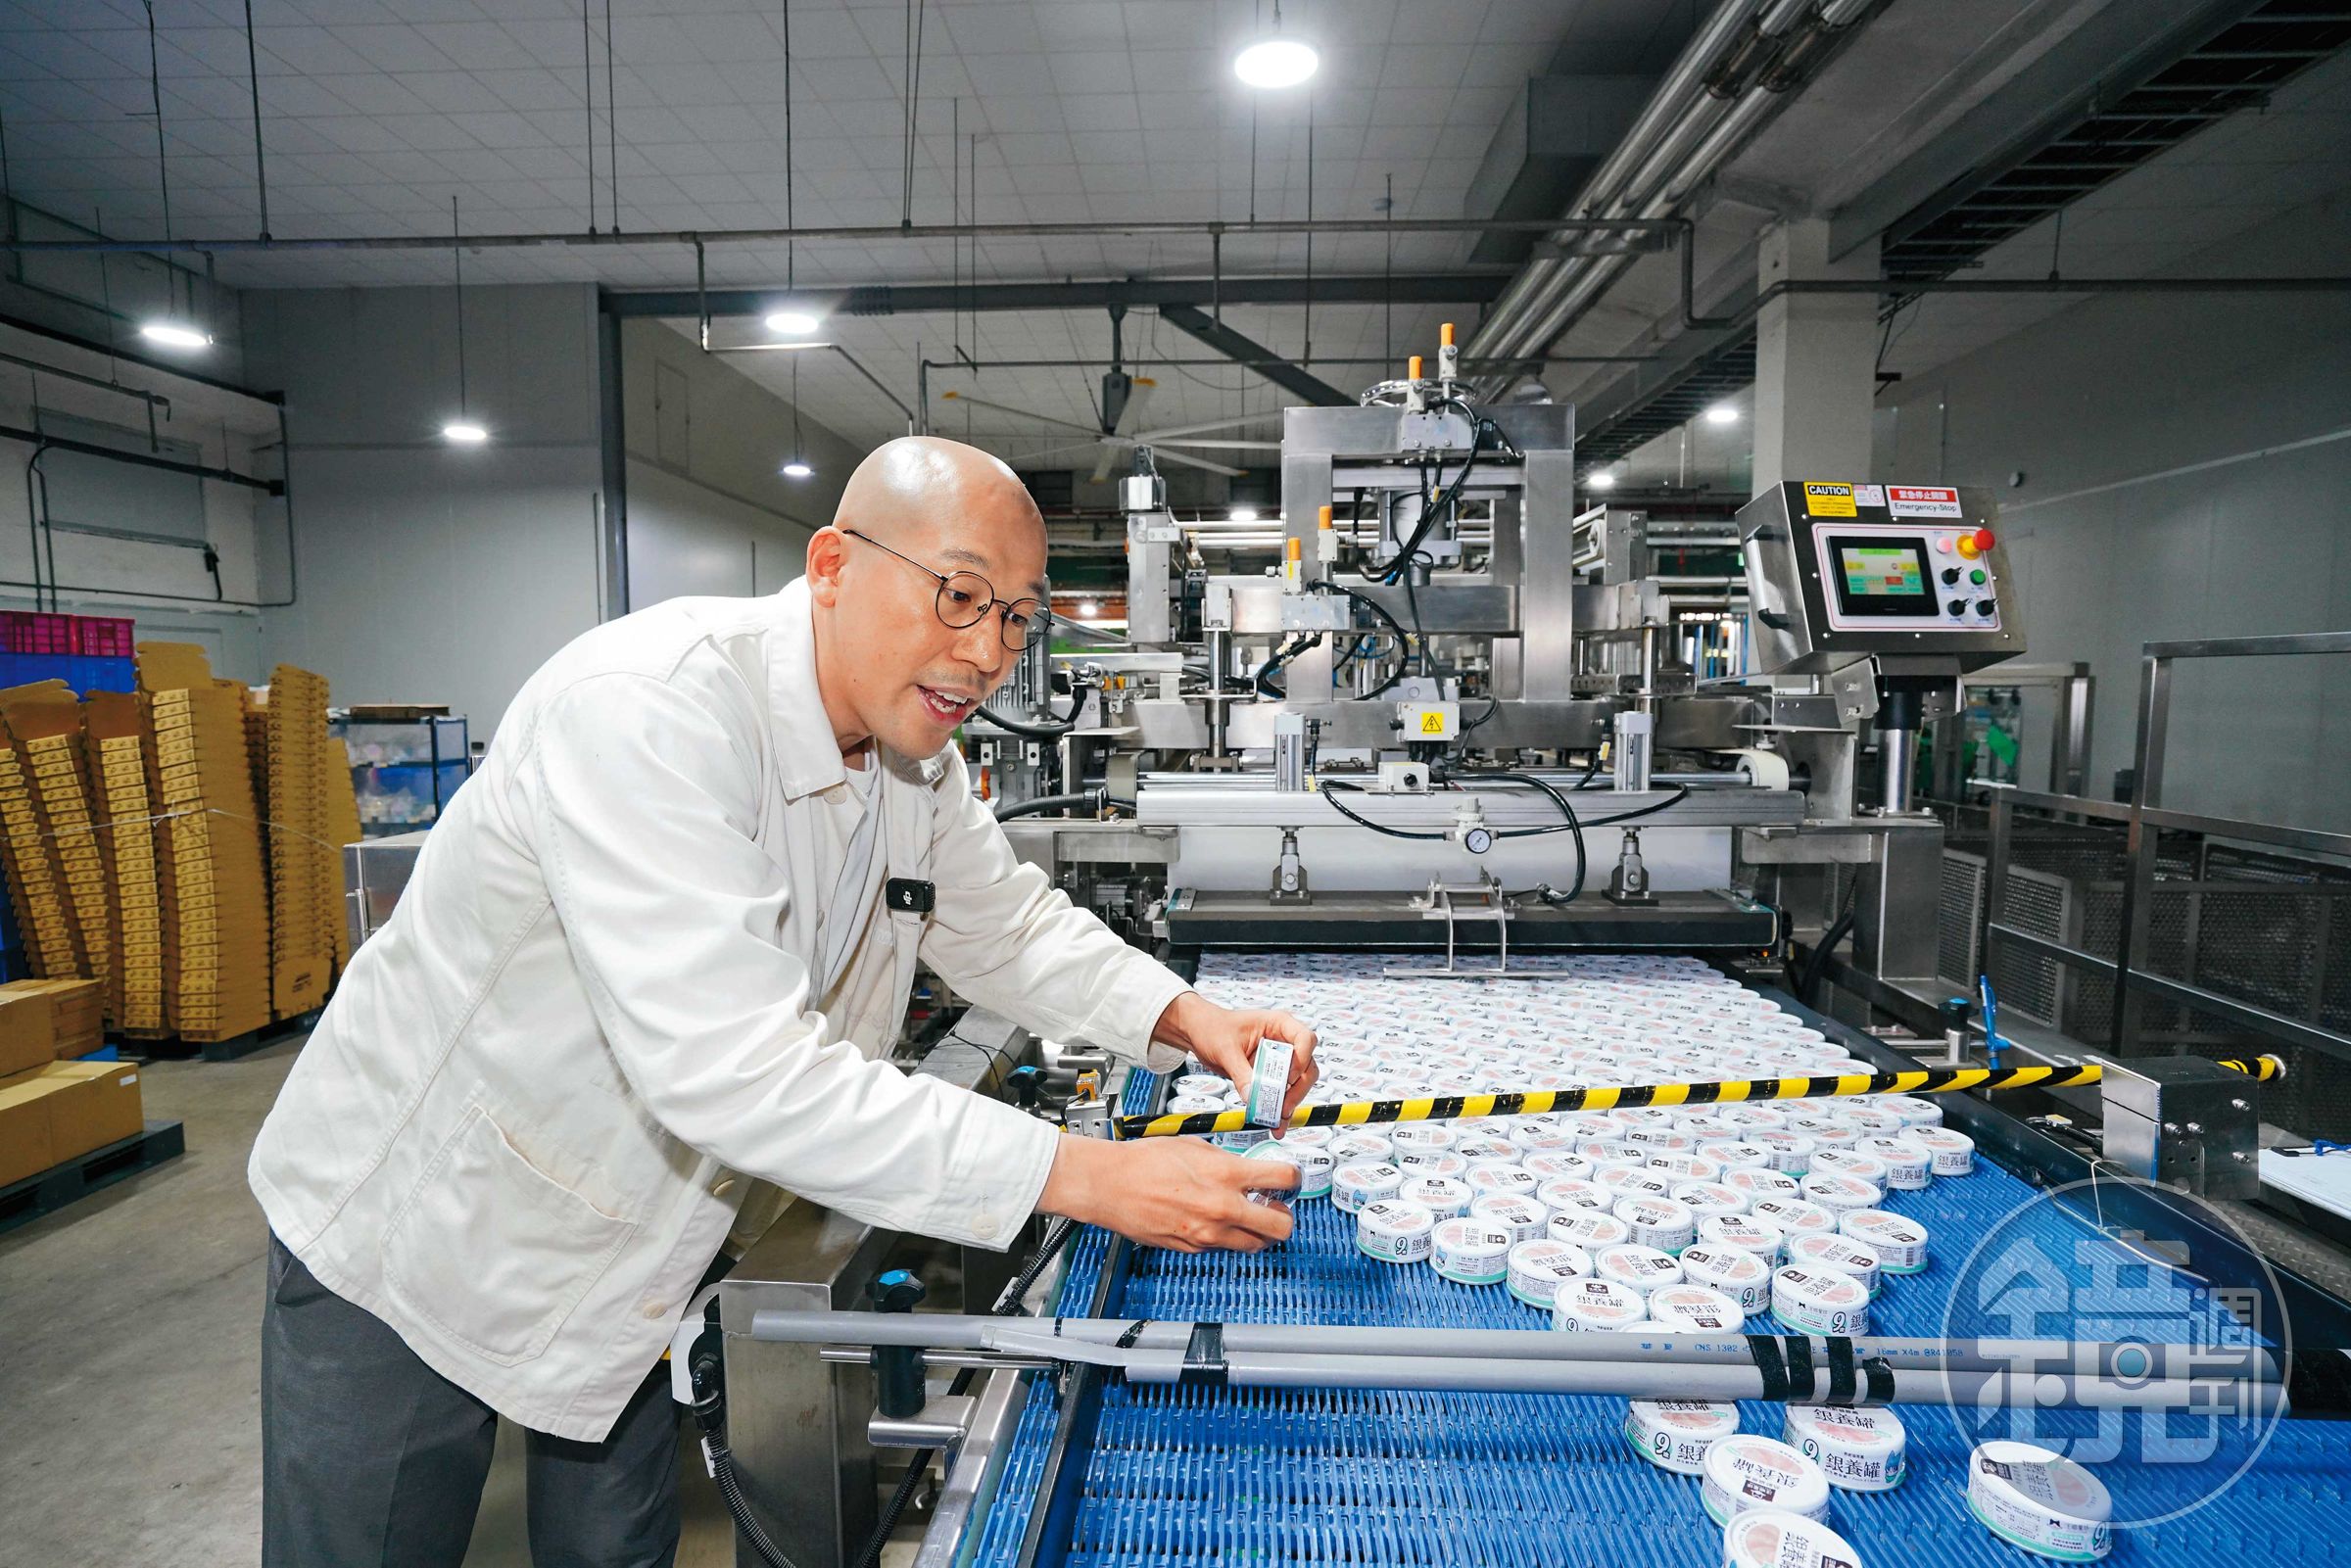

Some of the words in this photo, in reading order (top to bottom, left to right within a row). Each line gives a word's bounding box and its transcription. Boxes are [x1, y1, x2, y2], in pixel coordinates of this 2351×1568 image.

[1808, 485, 1849, 496] CAUTION
[1895, 502, 1957, 512] Emergency-Stop
[1825, 1452, 1882, 1479] 銀養罐
